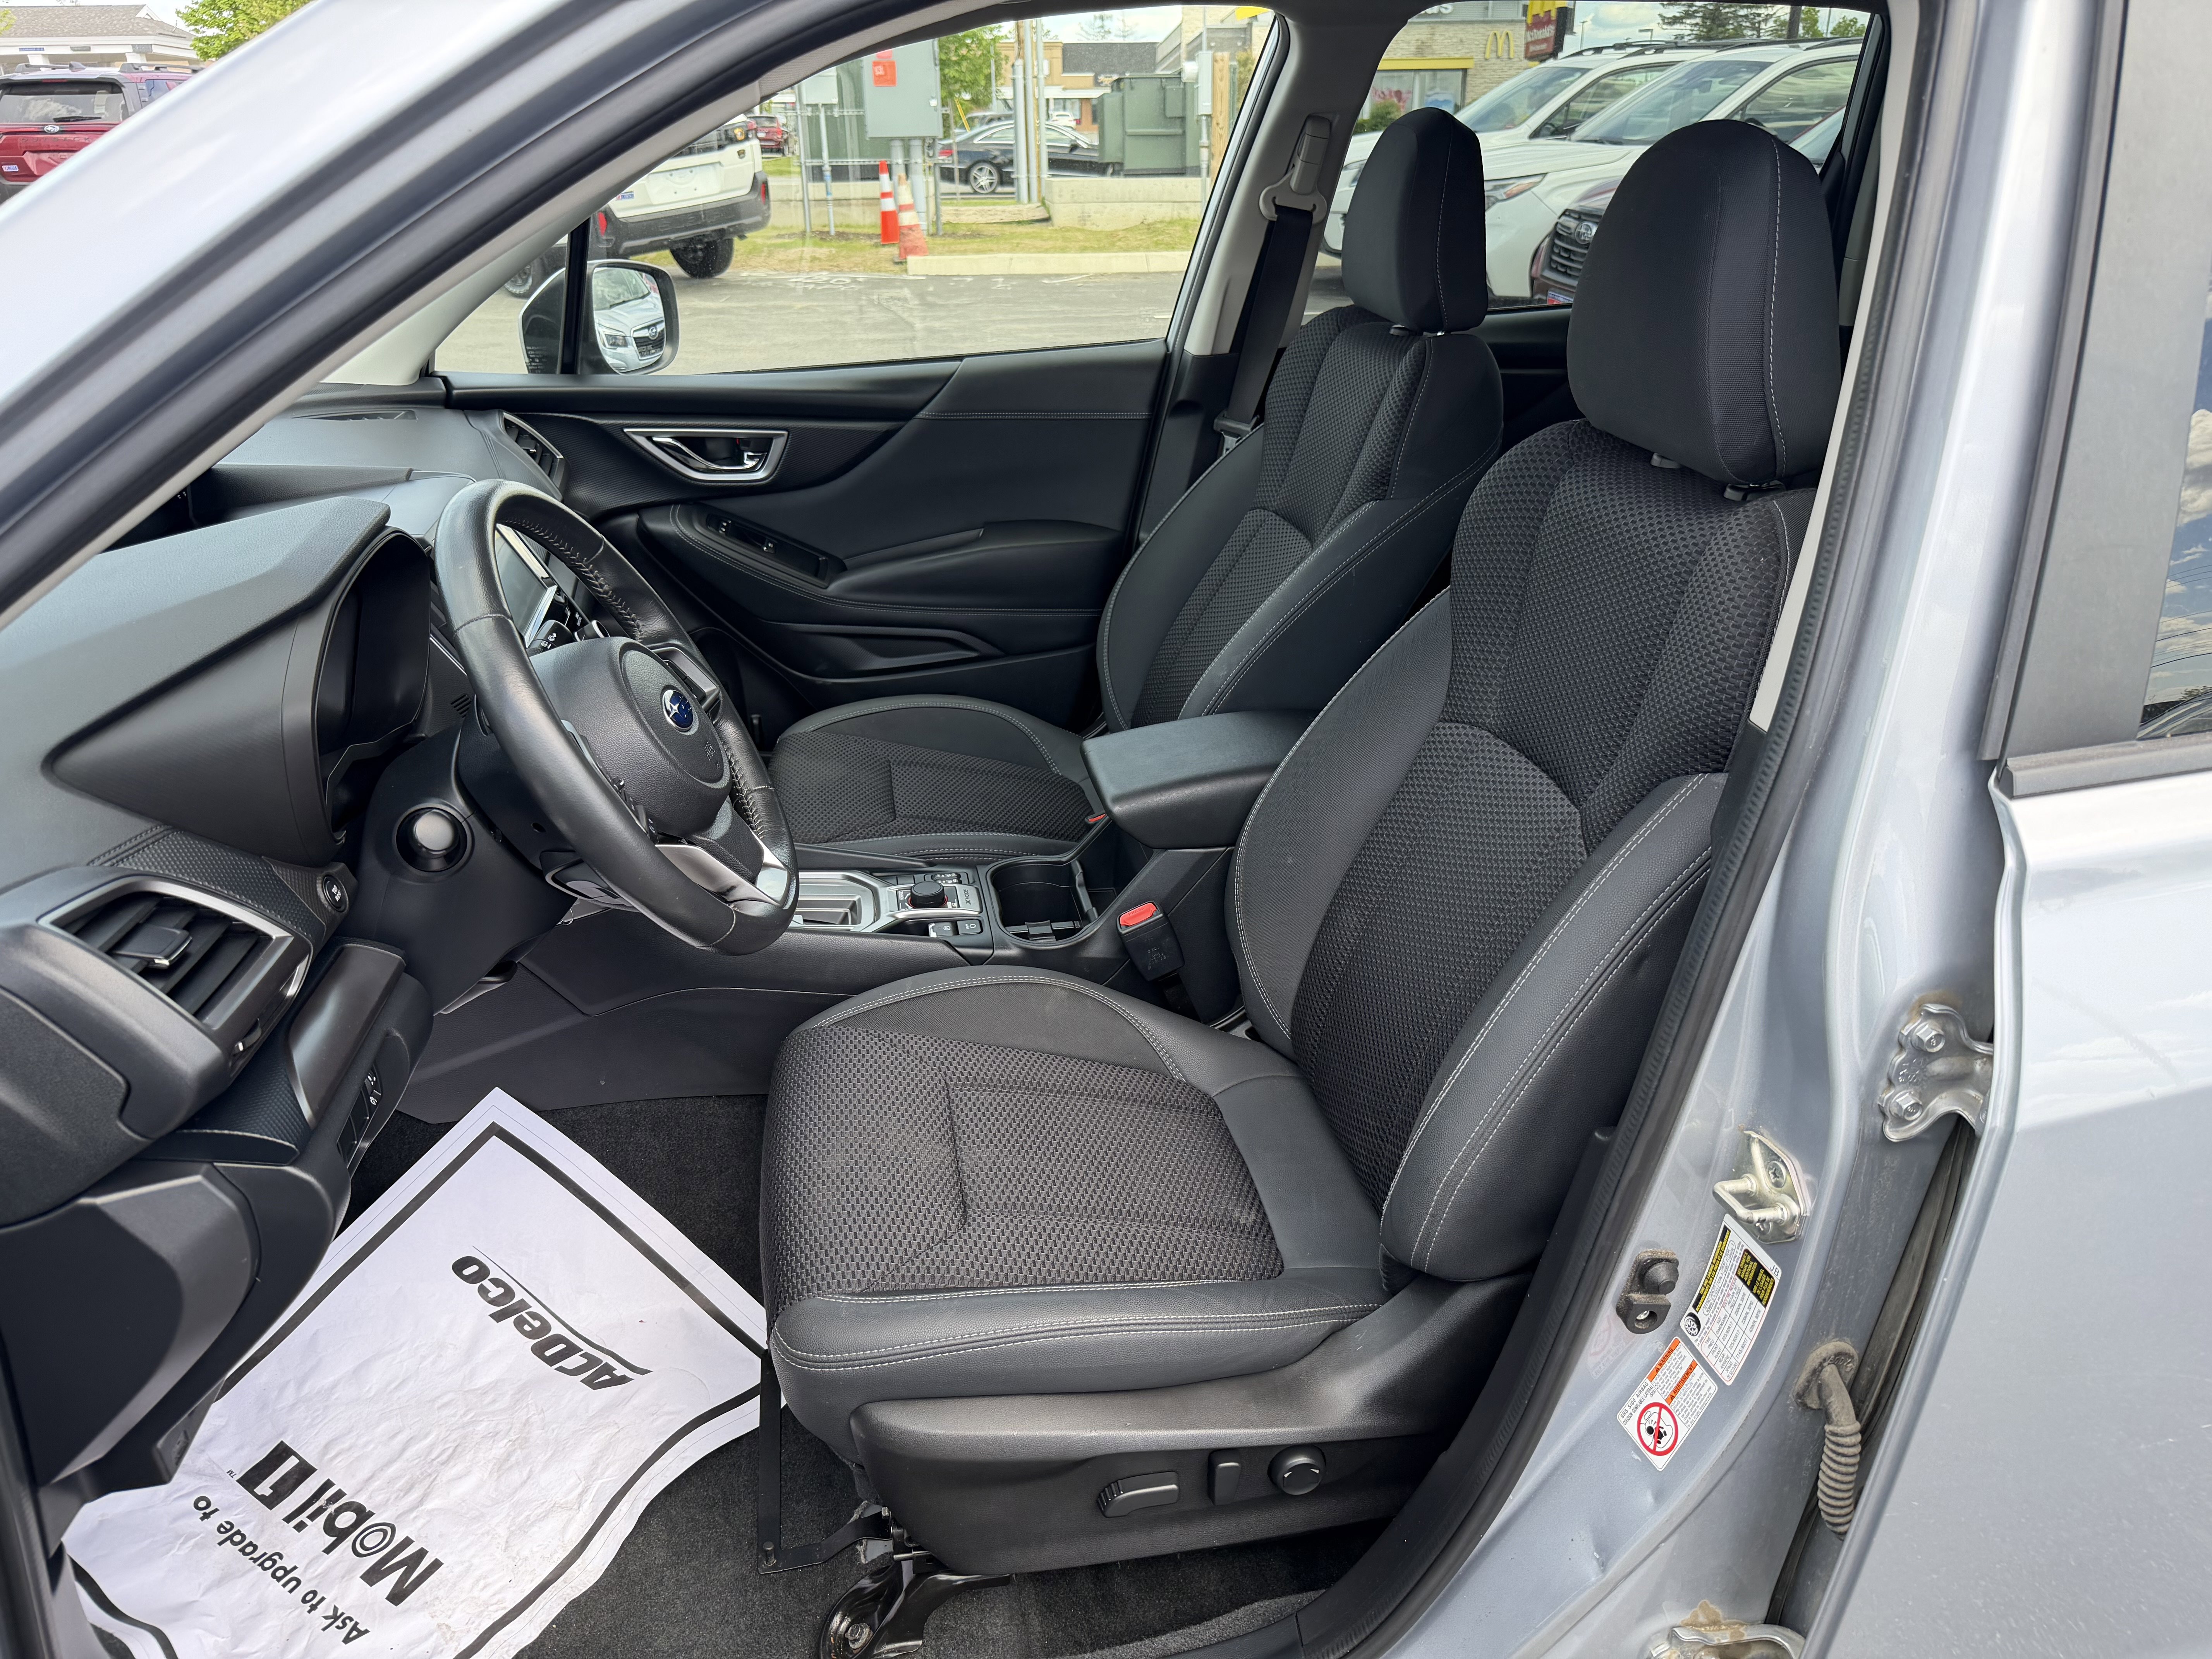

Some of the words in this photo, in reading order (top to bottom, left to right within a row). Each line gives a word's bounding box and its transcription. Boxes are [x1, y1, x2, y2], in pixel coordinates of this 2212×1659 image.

[1769, 1264, 1780, 1277] JB
[452, 1255, 635, 1391] ACDelco
[1658, 1347, 1673, 1367] WARNING
[1672, 1364, 1694, 1395] AVERTISSEMENT
[1627, 1397, 1636, 1409] SIDE
[1635, 1381, 1648, 1398] AIRBAG
[226, 1469, 237, 1478] TM
[193, 1496, 220, 1521] to
[282, 1478, 444, 1607] Mobil
[216, 1520, 302, 1594] upgrade
[301, 1589, 326, 1614] to
[321, 1604, 371, 1645] Ask
